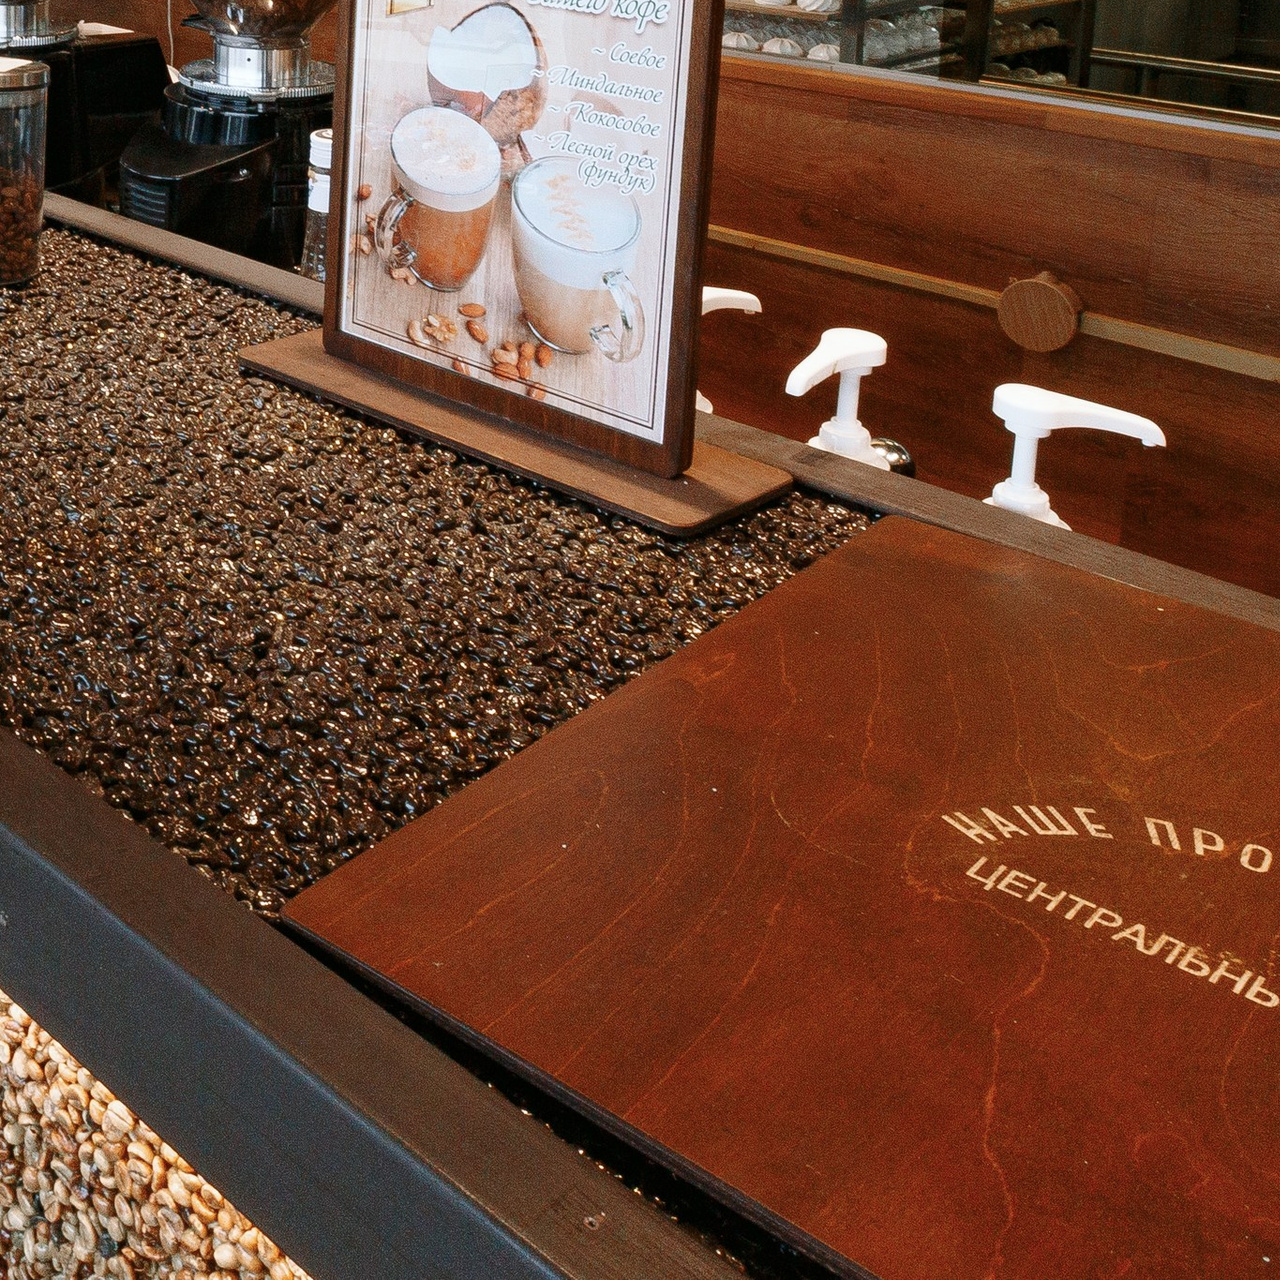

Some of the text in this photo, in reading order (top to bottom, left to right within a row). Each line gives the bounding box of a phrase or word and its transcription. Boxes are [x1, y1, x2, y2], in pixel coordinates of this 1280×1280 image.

[610, 42, 665, 69] Соевое
[548, 66, 663, 103] Миндальное
[565, 101, 660, 137] Кокосовое
[548, 132, 658, 172] Лесной орех
[578, 159, 656, 194] (фундук)
[941, 805, 1114, 844] НАШЕ
